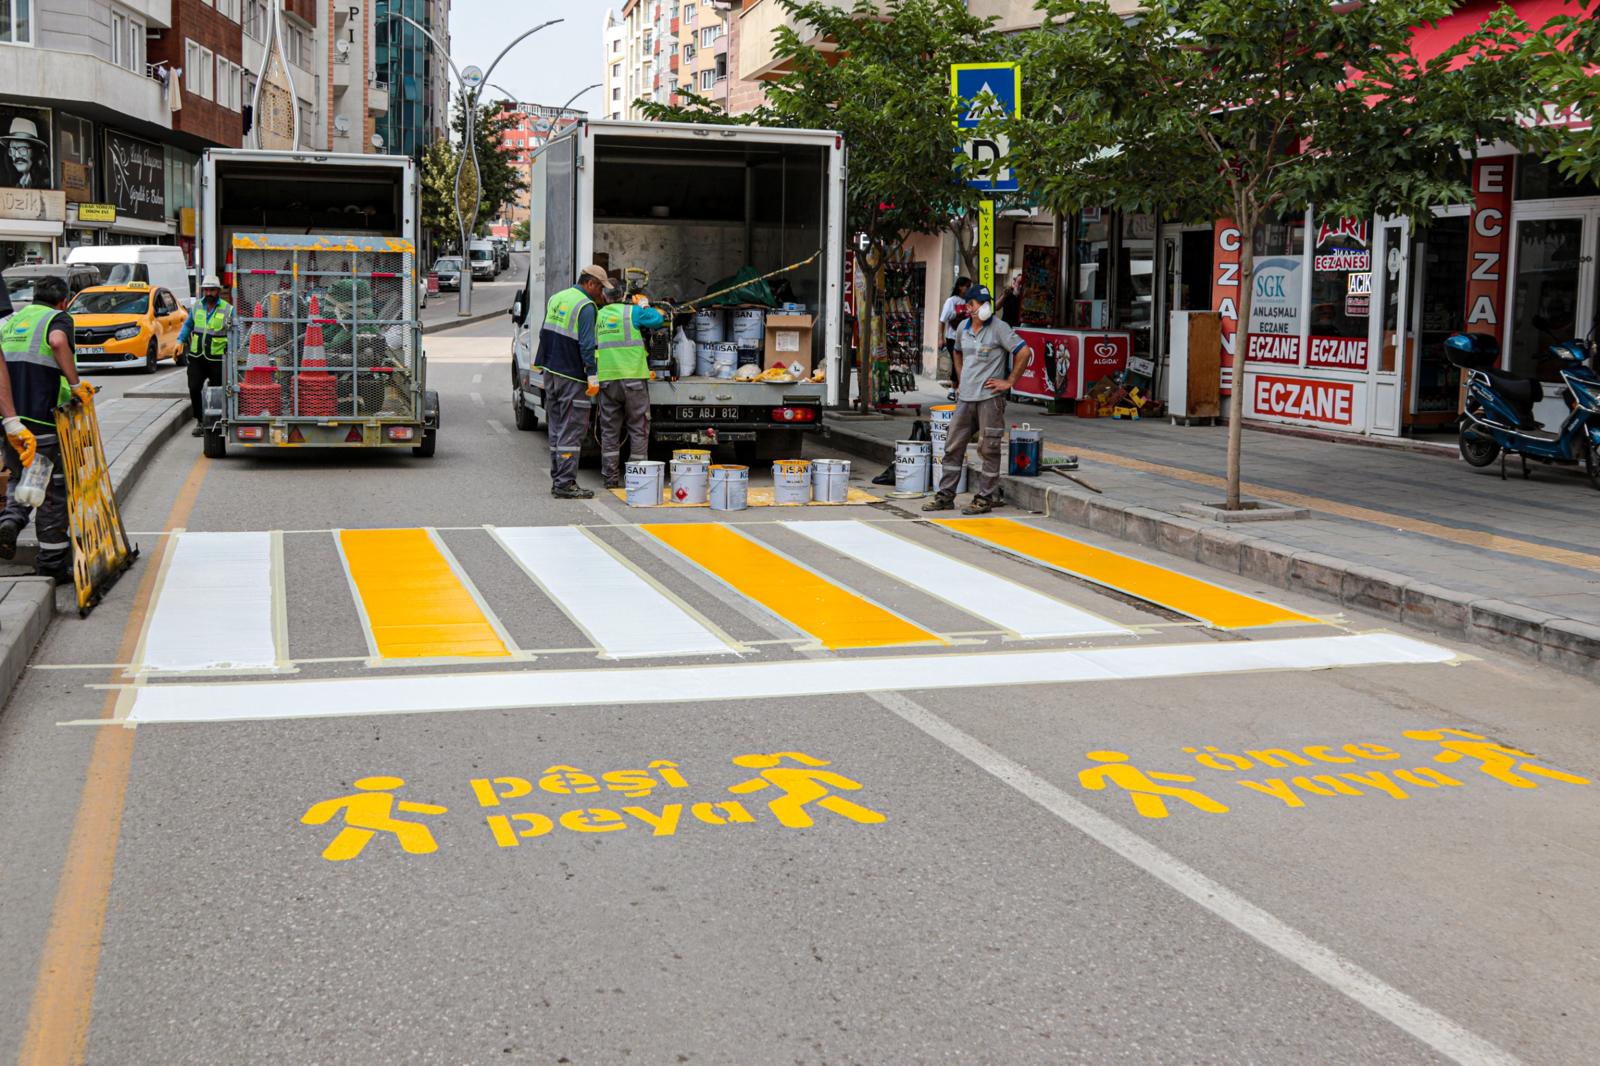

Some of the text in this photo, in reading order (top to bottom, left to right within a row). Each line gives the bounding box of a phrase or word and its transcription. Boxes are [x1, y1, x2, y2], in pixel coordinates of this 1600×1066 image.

[972, 139, 1000, 175] D
[1467, 164, 1504, 324] ECZA
[1256, 275, 1286, 297] SGK
[1216, 228, 1242, 390] CZANE
[1253, 307, 1297, 319] ANLAŞMALI
[1259, 322, 1289, 334] ECZANE
[1248, 337, 1299, 360] ECZANE
[1310, 340, 1366, 365] ECZANE
[682, 407, 737, 419] 65 ABJ 812
[1256, 379, 1351, 421] ECZANE
[1184, 743, 1401, 771] önce
[1237, 767, 1464, 808] yaya
[487, 801, 754, 847] peya
